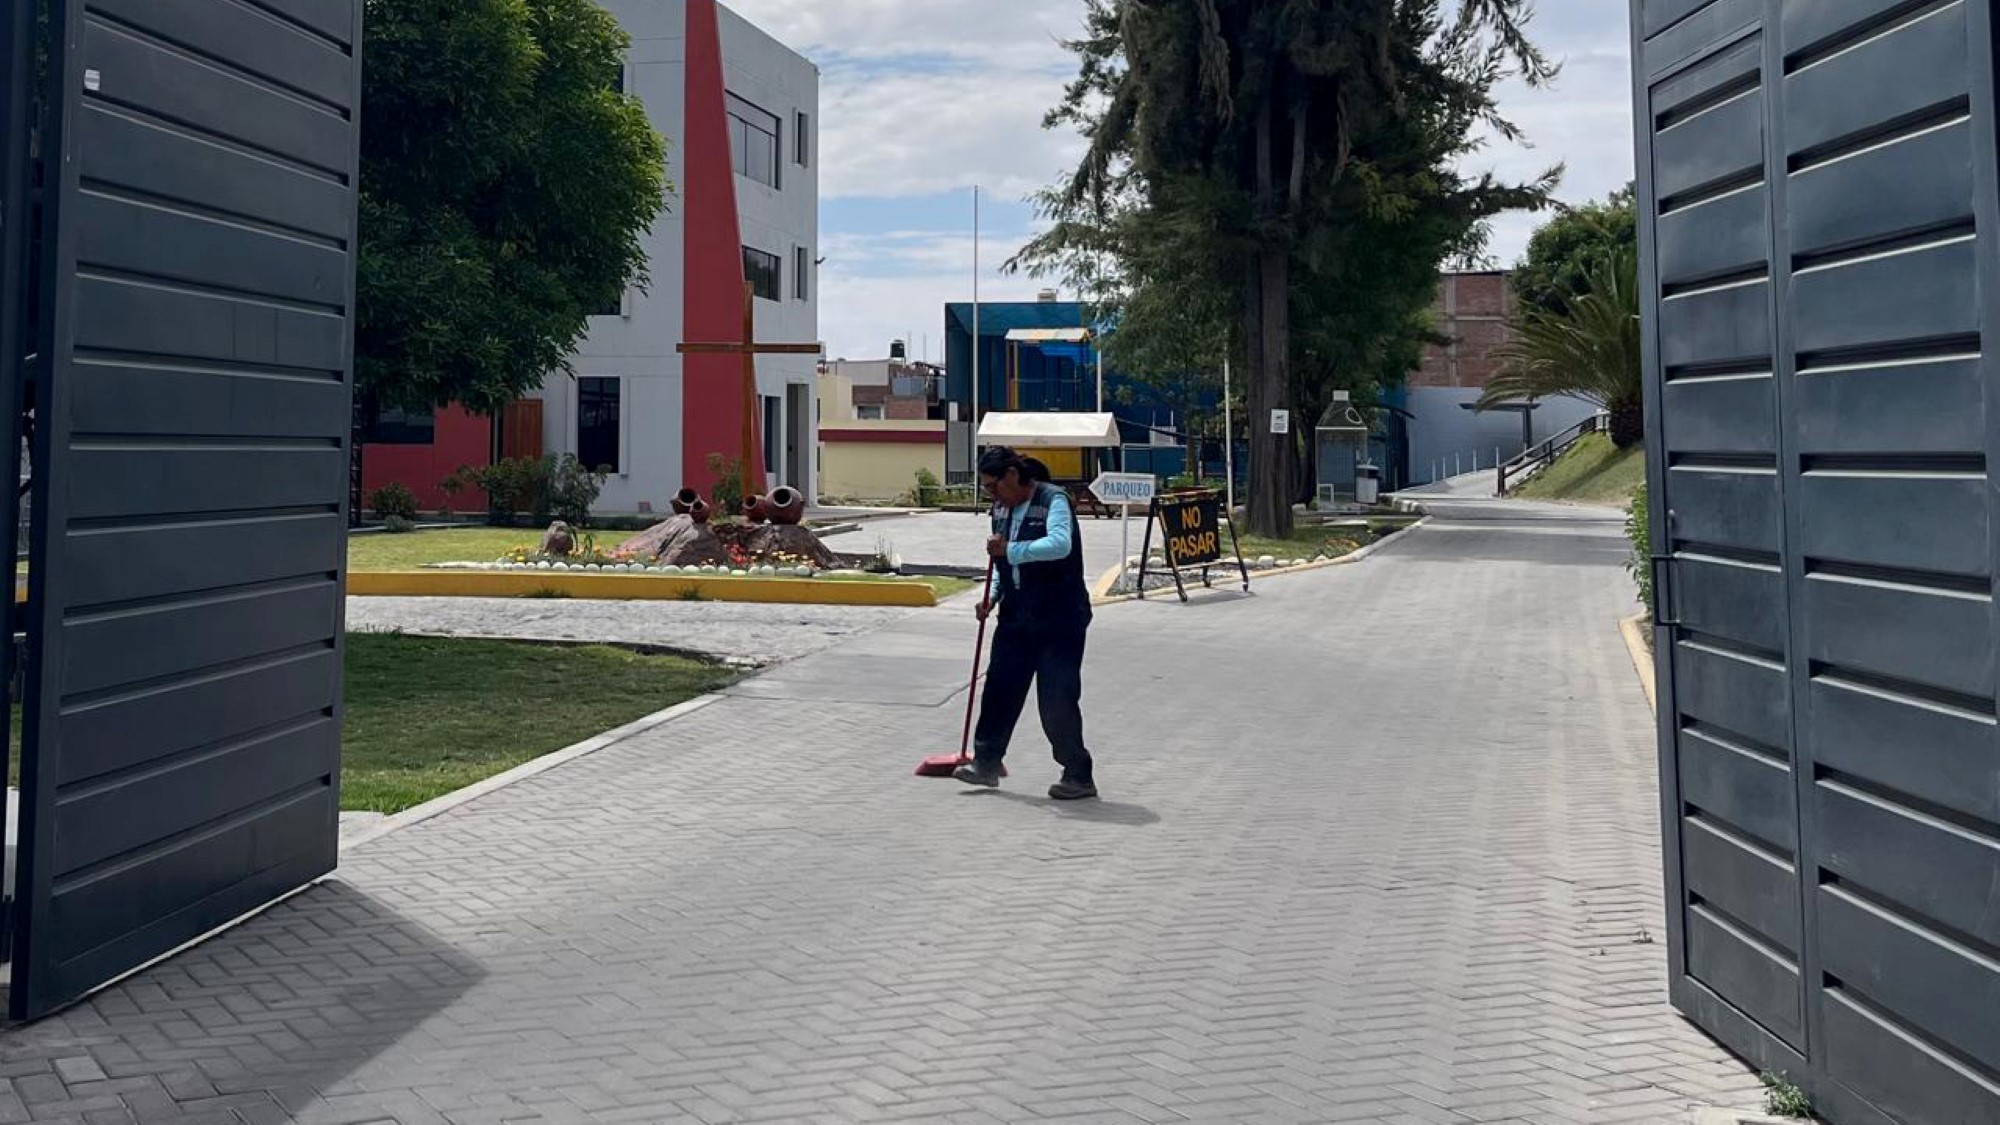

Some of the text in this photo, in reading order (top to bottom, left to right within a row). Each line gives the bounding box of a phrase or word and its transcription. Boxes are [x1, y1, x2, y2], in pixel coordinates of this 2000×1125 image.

[1103, 482, 1151, 498] PARQUEO
[1182, 506, 1202, 529] NO
[1170, 532, 1216, 558] PASAR
